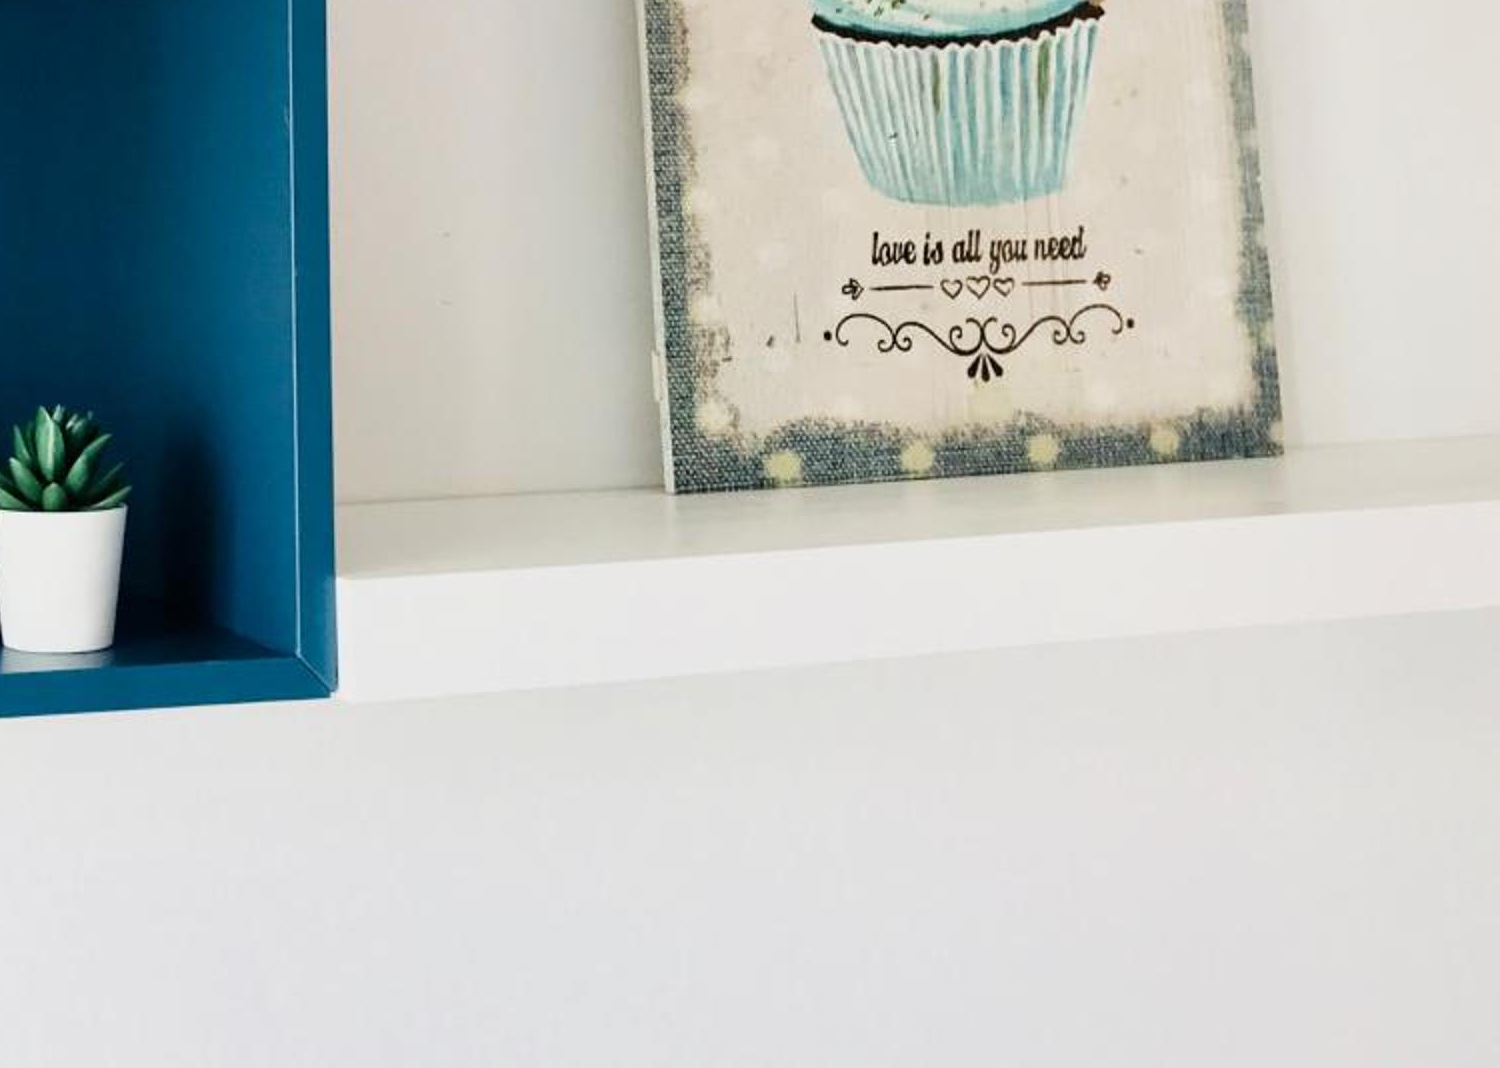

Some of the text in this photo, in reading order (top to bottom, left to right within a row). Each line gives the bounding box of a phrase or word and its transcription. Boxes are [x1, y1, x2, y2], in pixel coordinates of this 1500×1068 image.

[871, 225, 1088, 275] love is all you need
